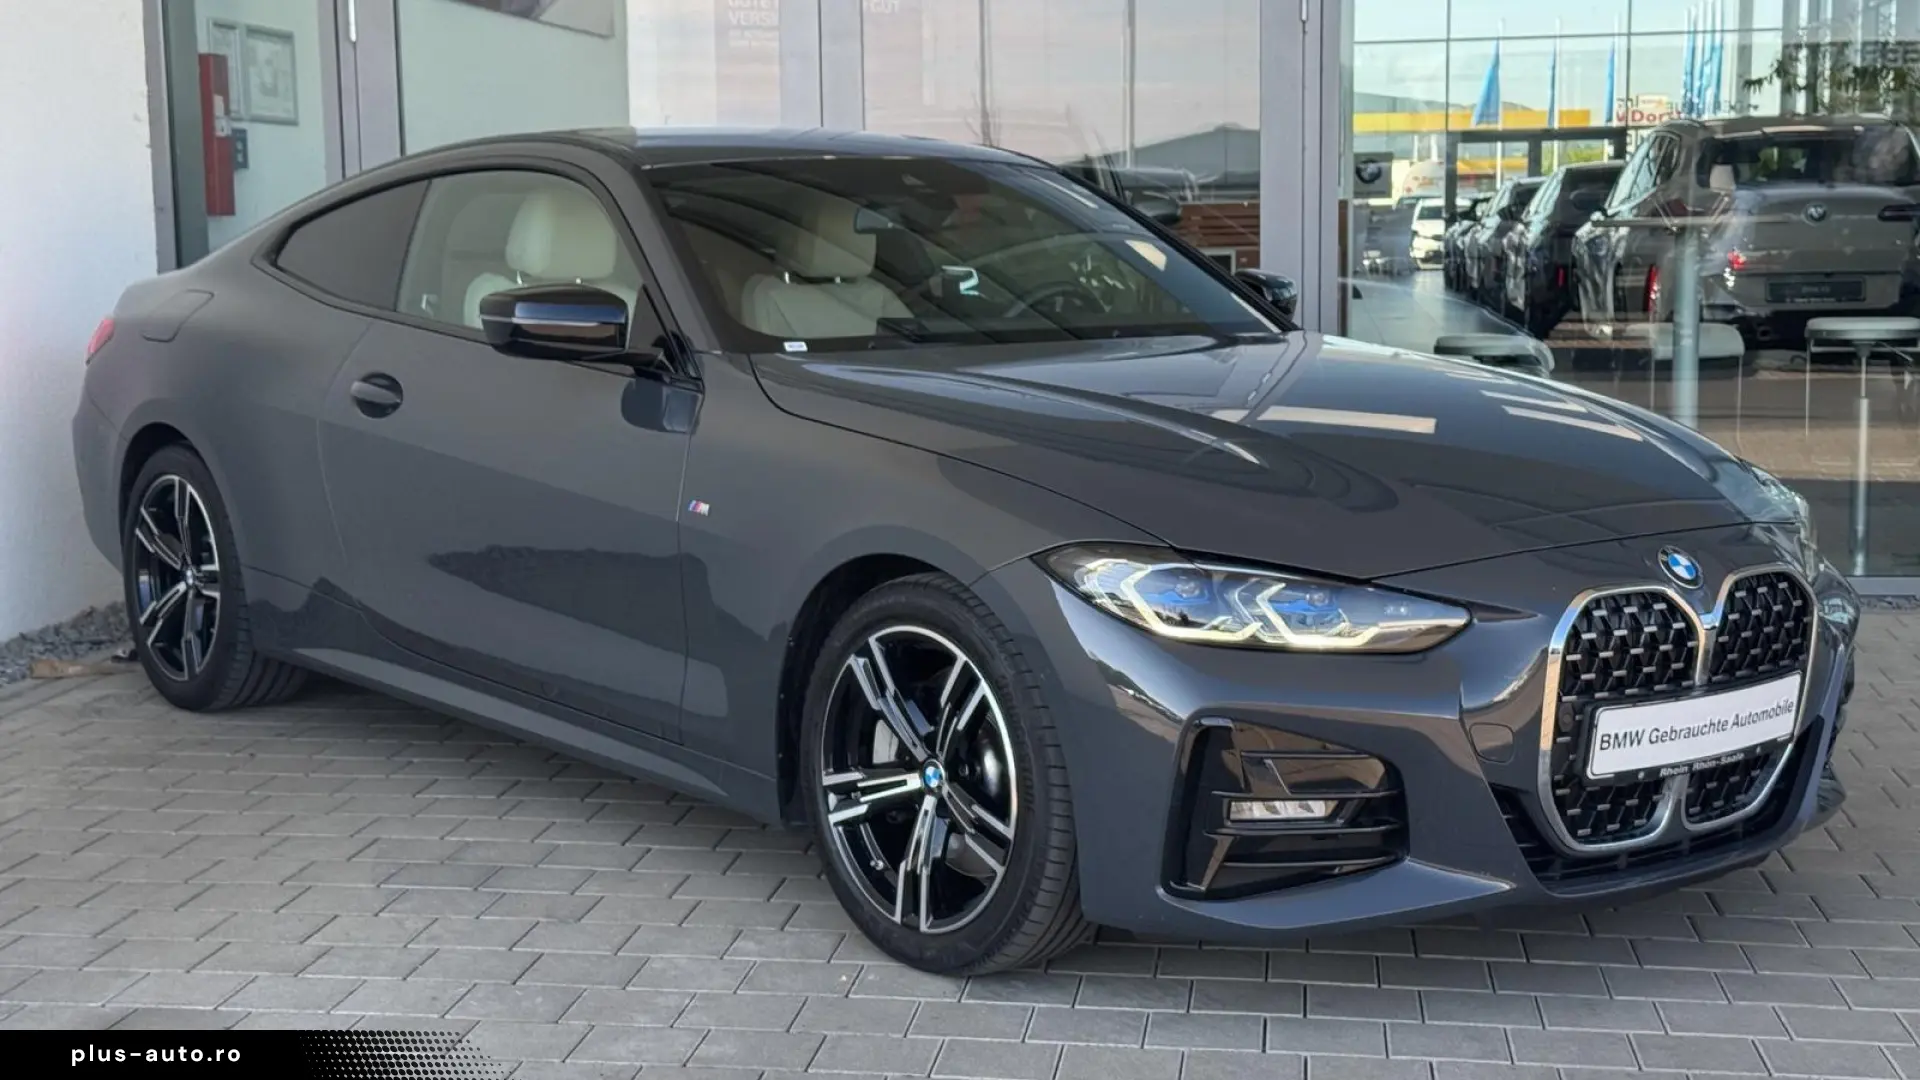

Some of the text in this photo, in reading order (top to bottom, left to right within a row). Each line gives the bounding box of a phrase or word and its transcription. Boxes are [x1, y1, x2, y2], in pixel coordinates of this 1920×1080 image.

[1600, 699, 1794, 751] BMW Gebrauchte Automobile
